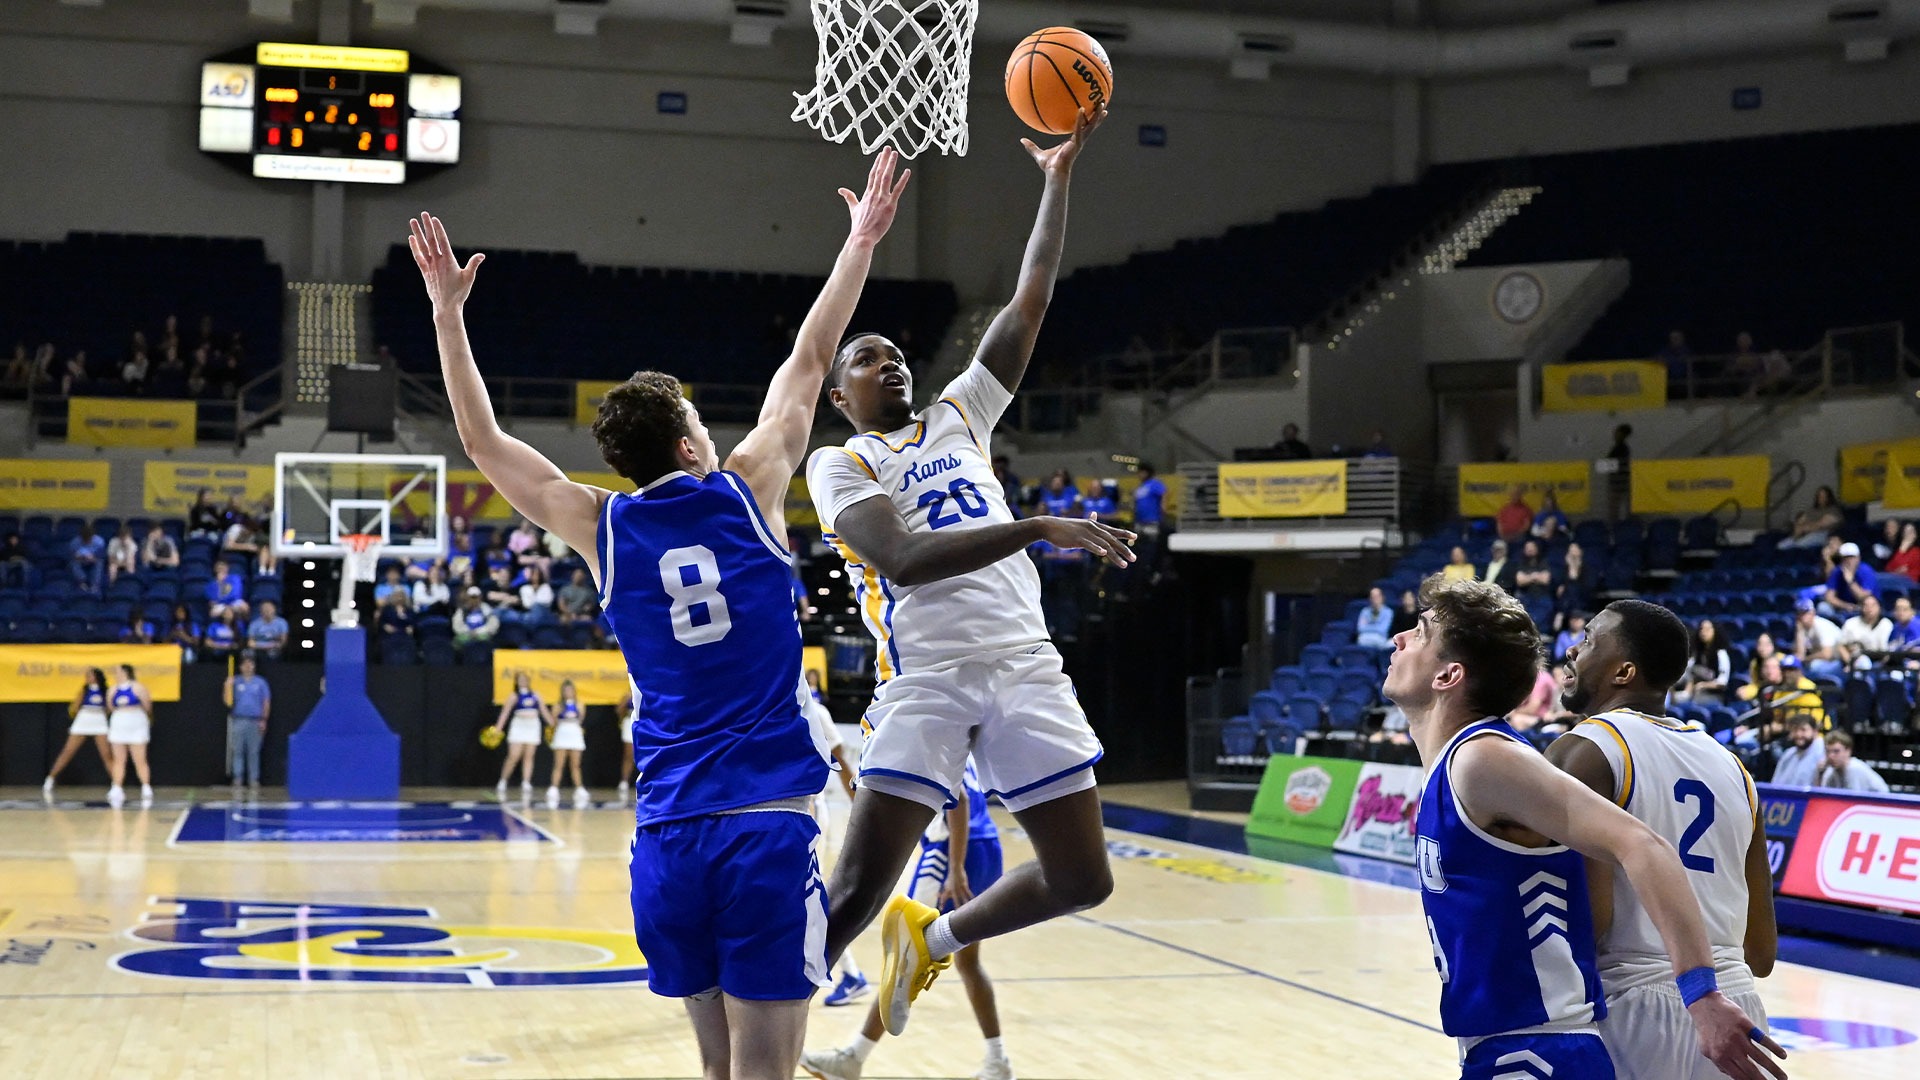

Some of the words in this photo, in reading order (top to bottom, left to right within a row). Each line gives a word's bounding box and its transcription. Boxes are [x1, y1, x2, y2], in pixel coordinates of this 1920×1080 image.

[899, 453, 962, 492] Rams
[917, 477, 989, 530] 20
[658, 544, 732, 647] 8
[18, 662, 52, 676] ASU
[1674, 777, 1715, 874] 2
